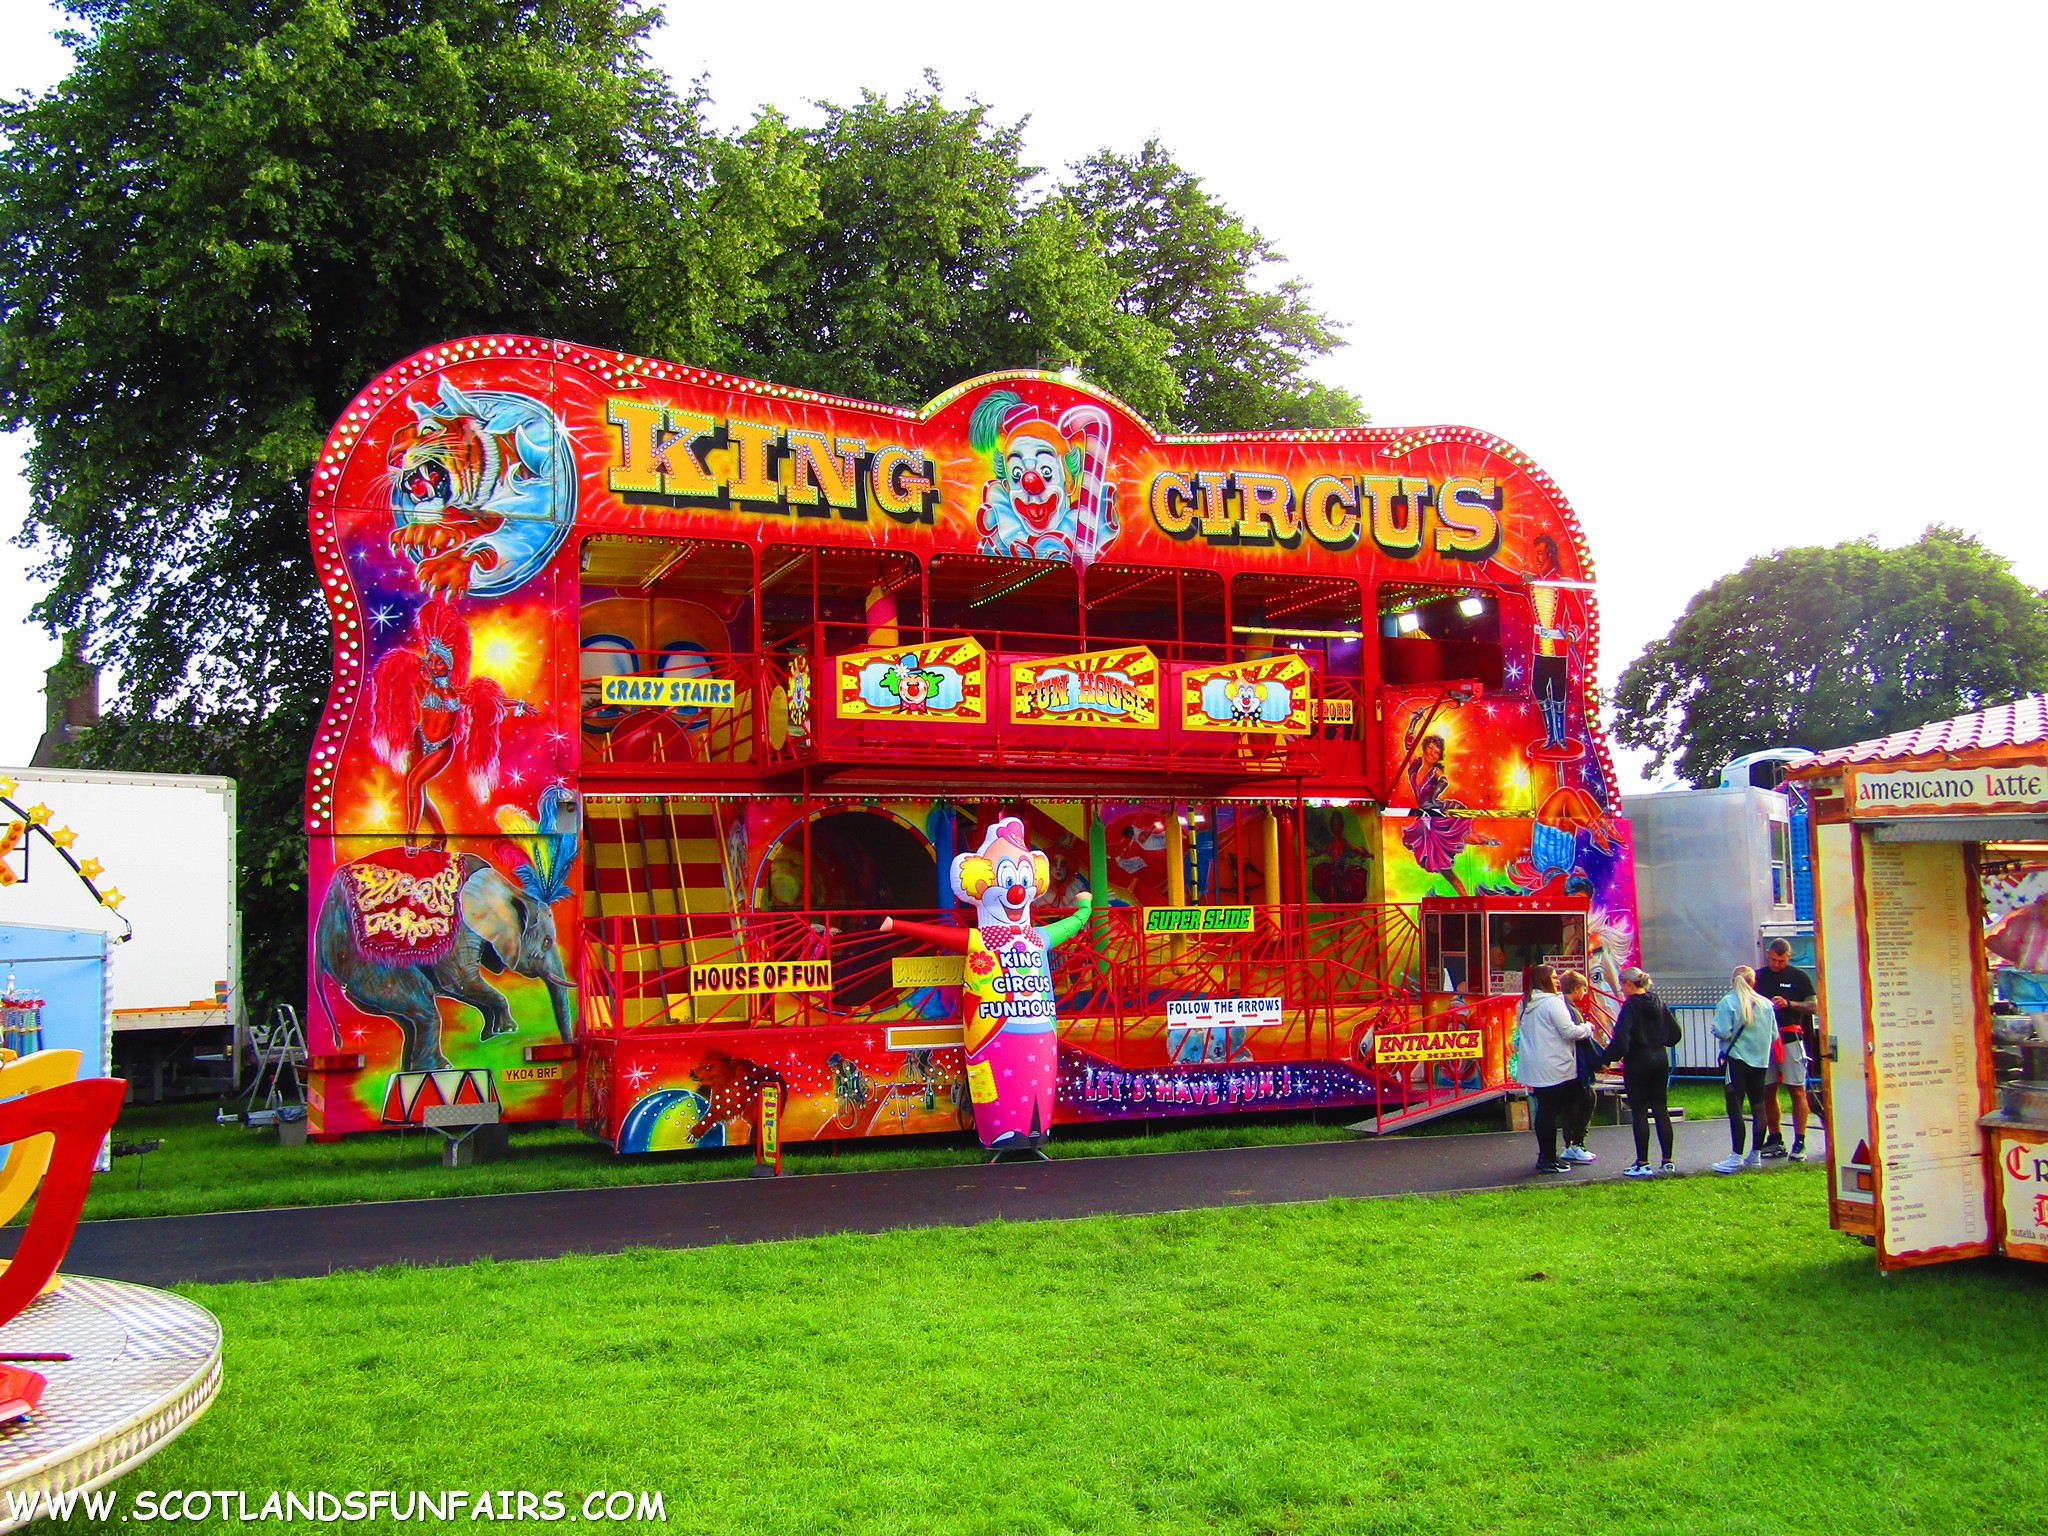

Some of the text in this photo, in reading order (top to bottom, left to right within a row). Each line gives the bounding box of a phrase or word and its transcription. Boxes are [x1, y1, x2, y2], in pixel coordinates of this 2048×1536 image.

[607, 397, 934, 517] KING
[1152, 470, 1499, 554] CIRCUS
[605, 680, 731, 703] CRAZY STAIRS
[1022, 672, 1149, 717] FUN HOUSE
[1146, 908, 1251, 930] SUPER SLIDE
[694, 965, 829, 991] HOUSE OF FUN
[1169, 1000, 1280, 1015] FOLLOW THE ARROWS
[1378, 1033, 1479, 1053] ENTRANCE
[1427, 1051, 1475, 1059] HERE
[506, 1067, 558, 1080] YK04 BRF
[1085, 1068, 1147, 1102] LET'S
[1156, 1079, 1220, 1105] HAVE
